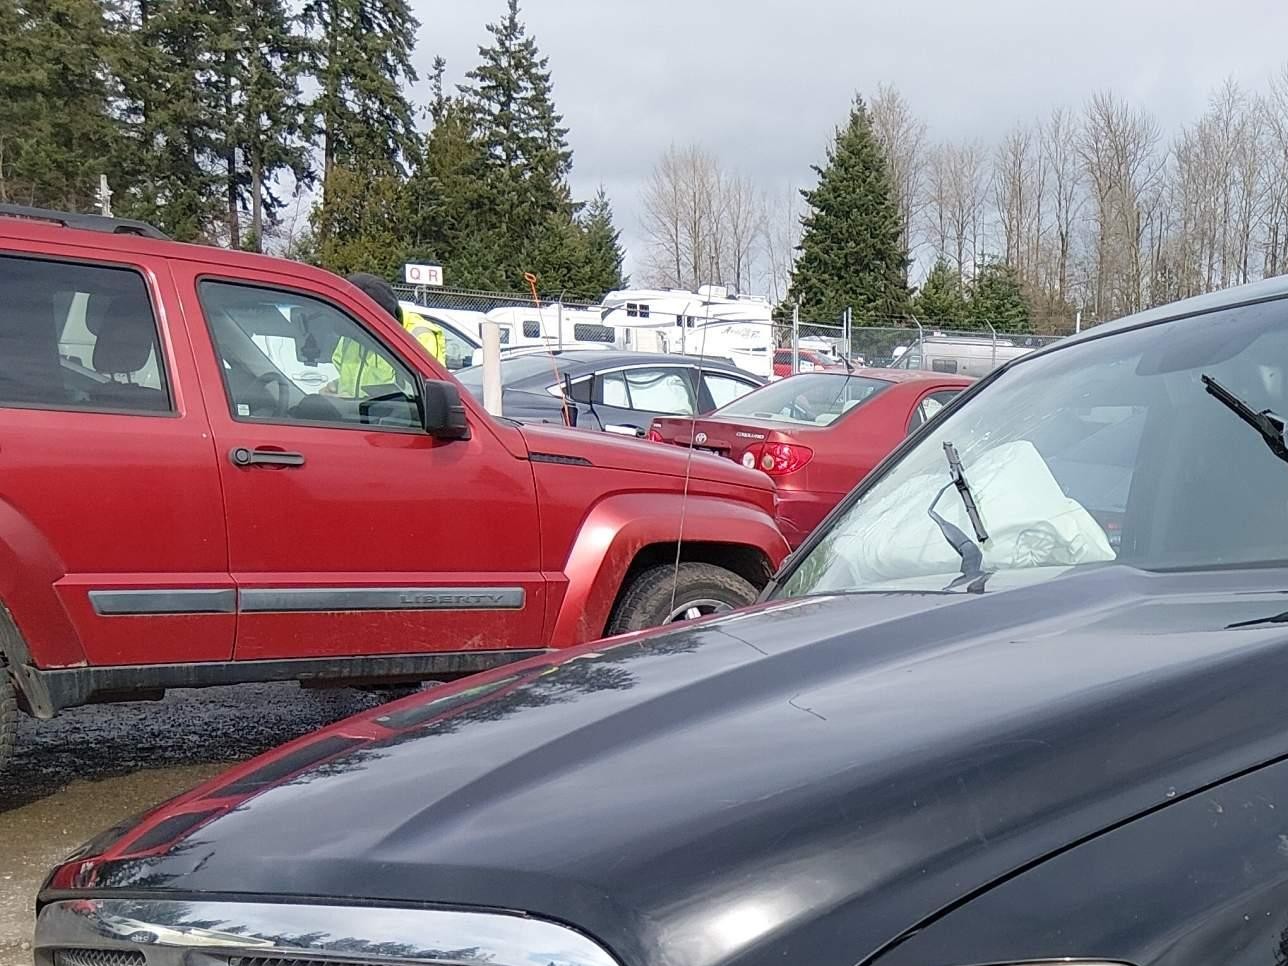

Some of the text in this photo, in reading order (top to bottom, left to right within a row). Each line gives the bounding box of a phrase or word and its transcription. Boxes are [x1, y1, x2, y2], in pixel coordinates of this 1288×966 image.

[409, 267, 438, 282] Q R
[399, 594, 504, 604] LIBERTY
